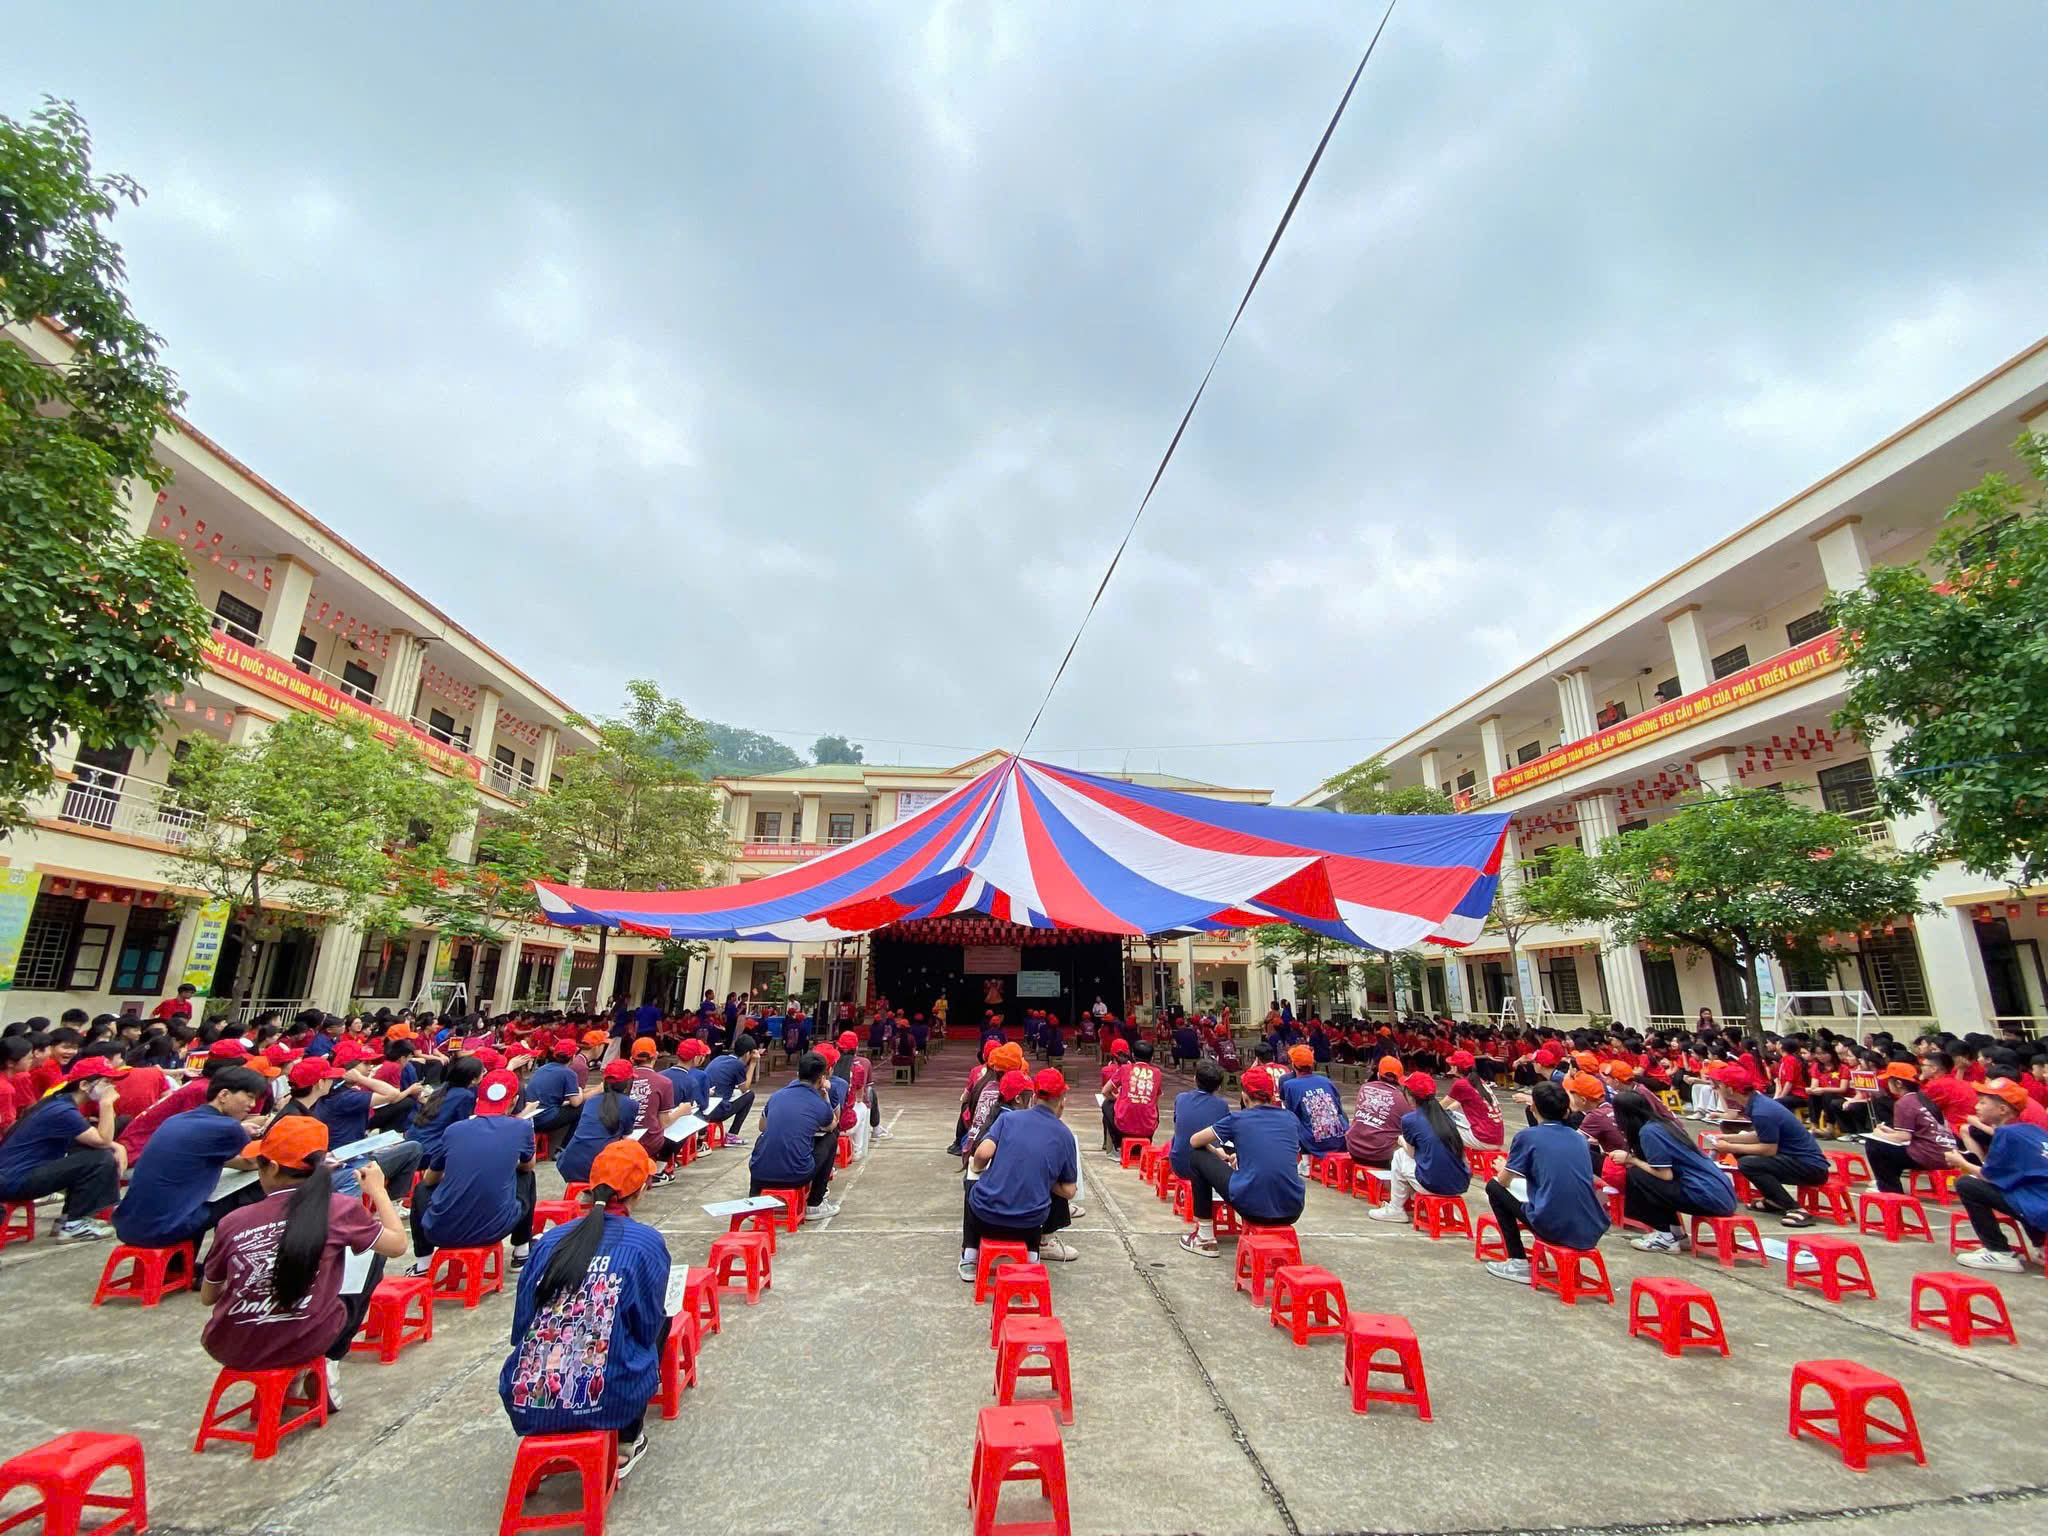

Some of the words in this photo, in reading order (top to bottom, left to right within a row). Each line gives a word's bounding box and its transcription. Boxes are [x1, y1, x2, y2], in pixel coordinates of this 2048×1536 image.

[227, 648, 239, 665] LÀ
[240, 655, 265, 678] QUỐC
[265, 665, 288, 687] SÁCH
[329, 697, 340, 712] LÀ
[1659, 711, 1674, 728] YÊU
[1676, 702, 1693, 720] CẦU
[1694, 695, 1711, 713] MỚI
[1712, 687, 1732, 706] CỦA
[1732, 678, 1756, 700] PHÁT
[1757, 663, 1788, 689] TRIỂN
[1816, 642, 1831, 665] TẾ
[228, 1295, 280, 1318] Only
